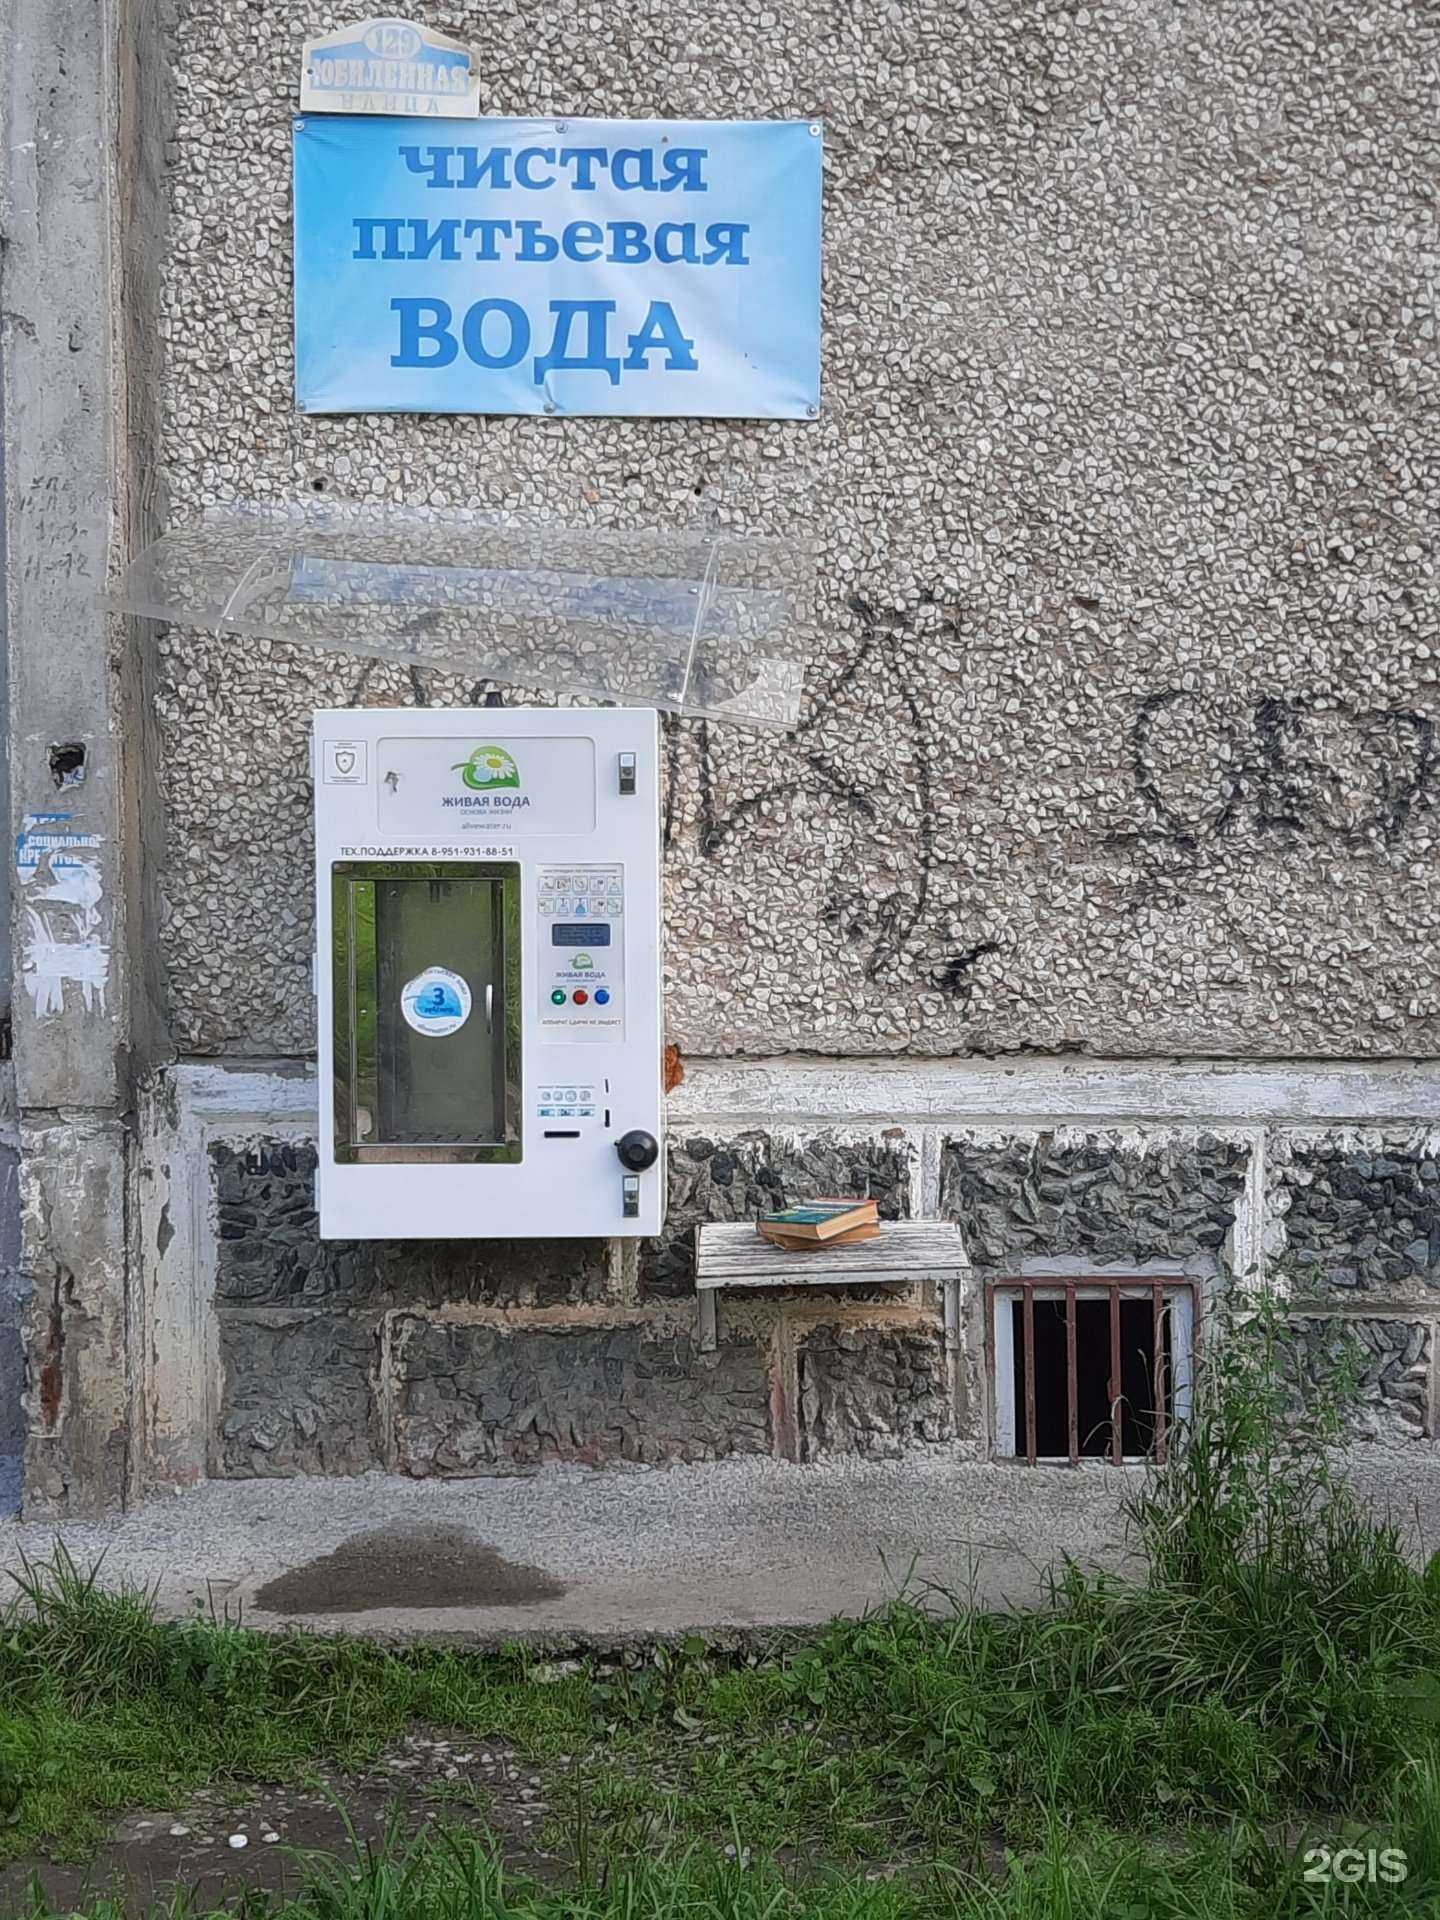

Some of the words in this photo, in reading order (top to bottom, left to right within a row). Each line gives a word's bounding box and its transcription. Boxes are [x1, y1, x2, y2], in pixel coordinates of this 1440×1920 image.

[374, 28, 416, 51] 129
[399, 145, 708, 192] чистая
[352, 218, 750, 265] питьевая
[390, 297, 699, 385] ВОДА
[442, 797, 490, 807] ЖИВАЯ
[494, 797, 530, 809] ВОДА
[431, 847, 514, 856] 8-951-931-88-51
[432, 987, 445, 1006] 3
